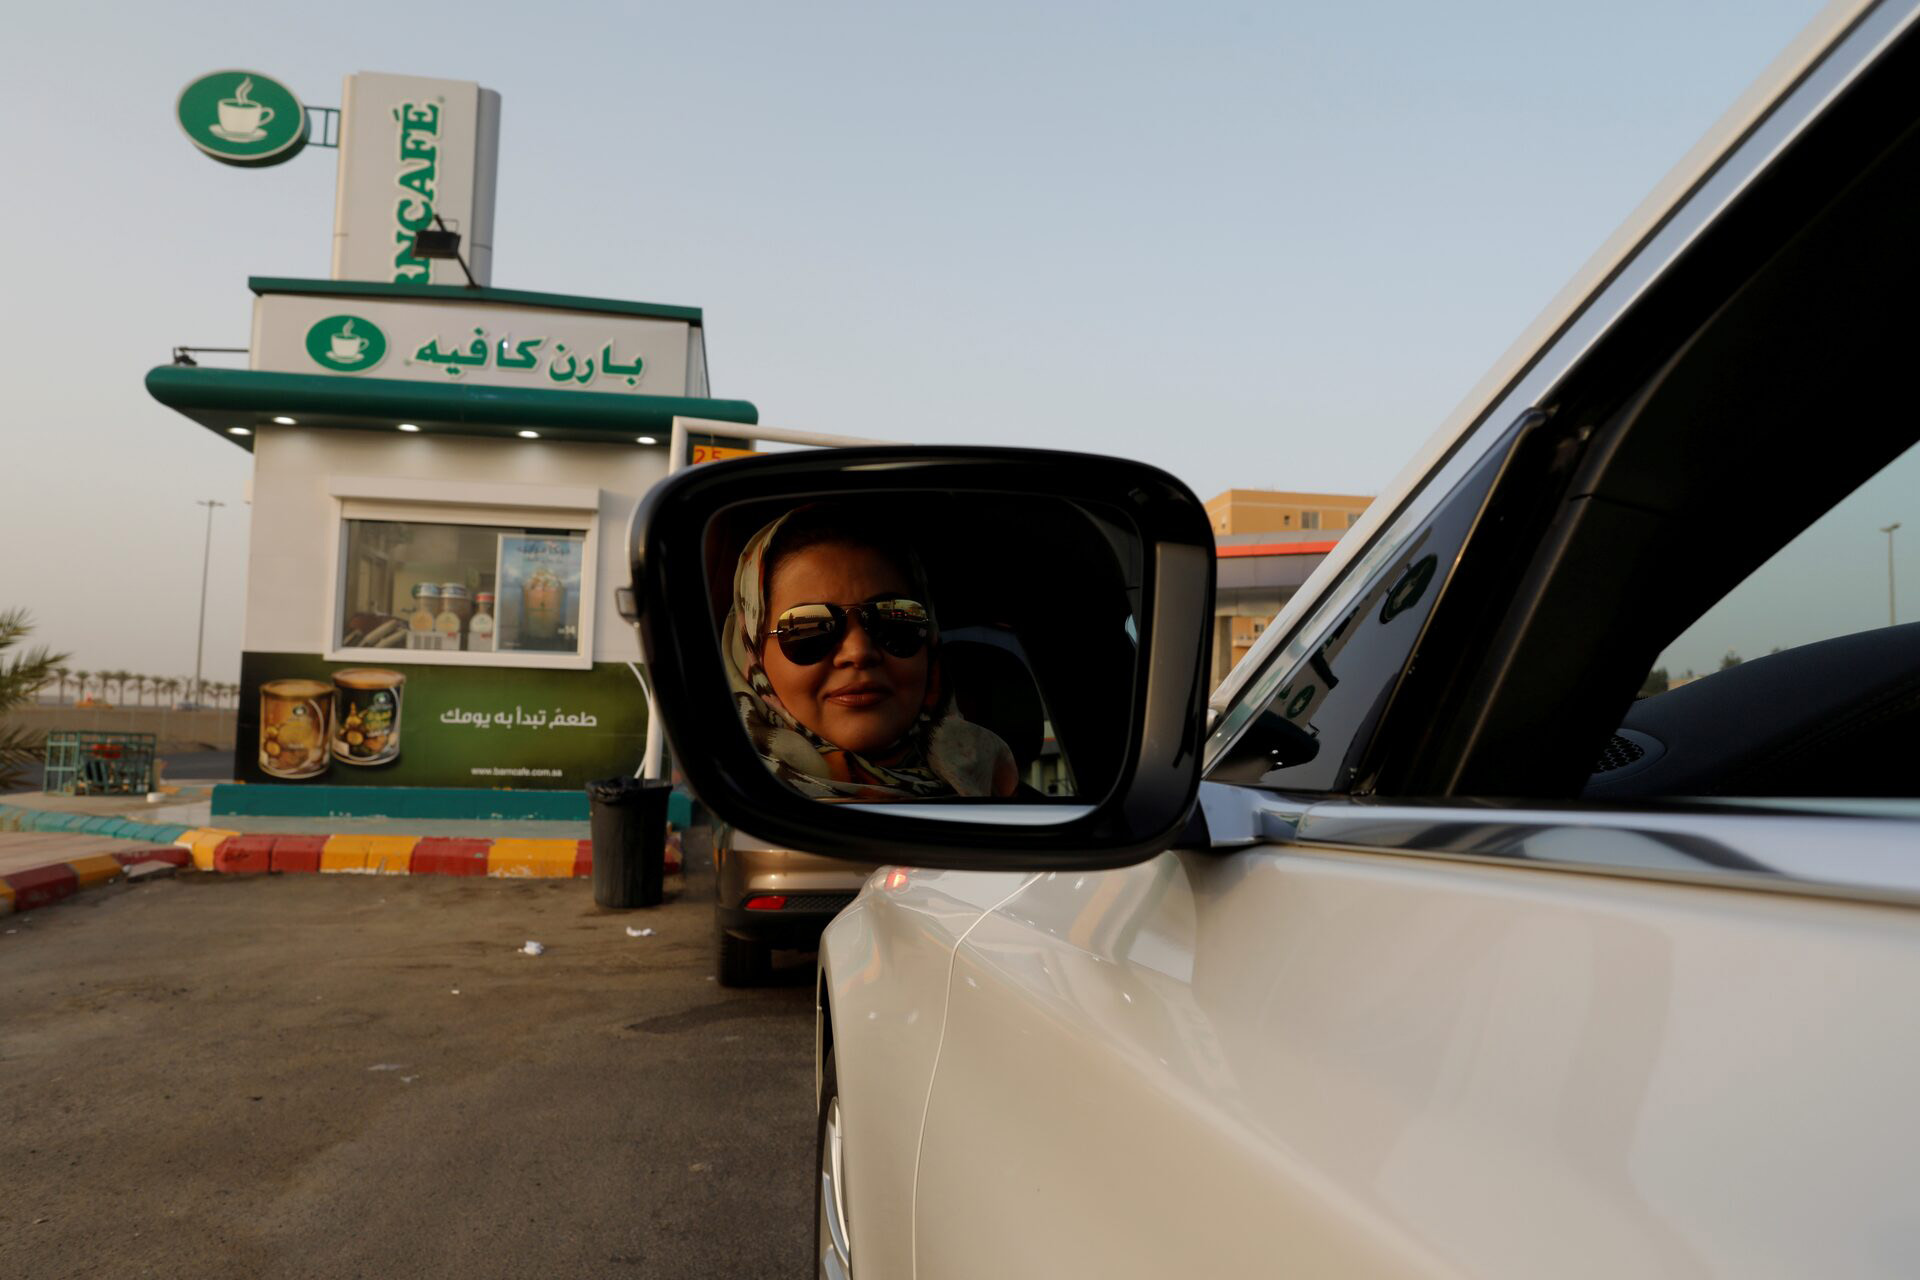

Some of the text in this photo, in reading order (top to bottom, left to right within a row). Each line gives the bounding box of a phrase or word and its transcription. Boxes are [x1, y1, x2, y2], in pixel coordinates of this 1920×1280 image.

[414, 326, 644, 386] بارن كافيه
[440, 707, 491, 729] يومك
[494, 711, 513, 729] به
